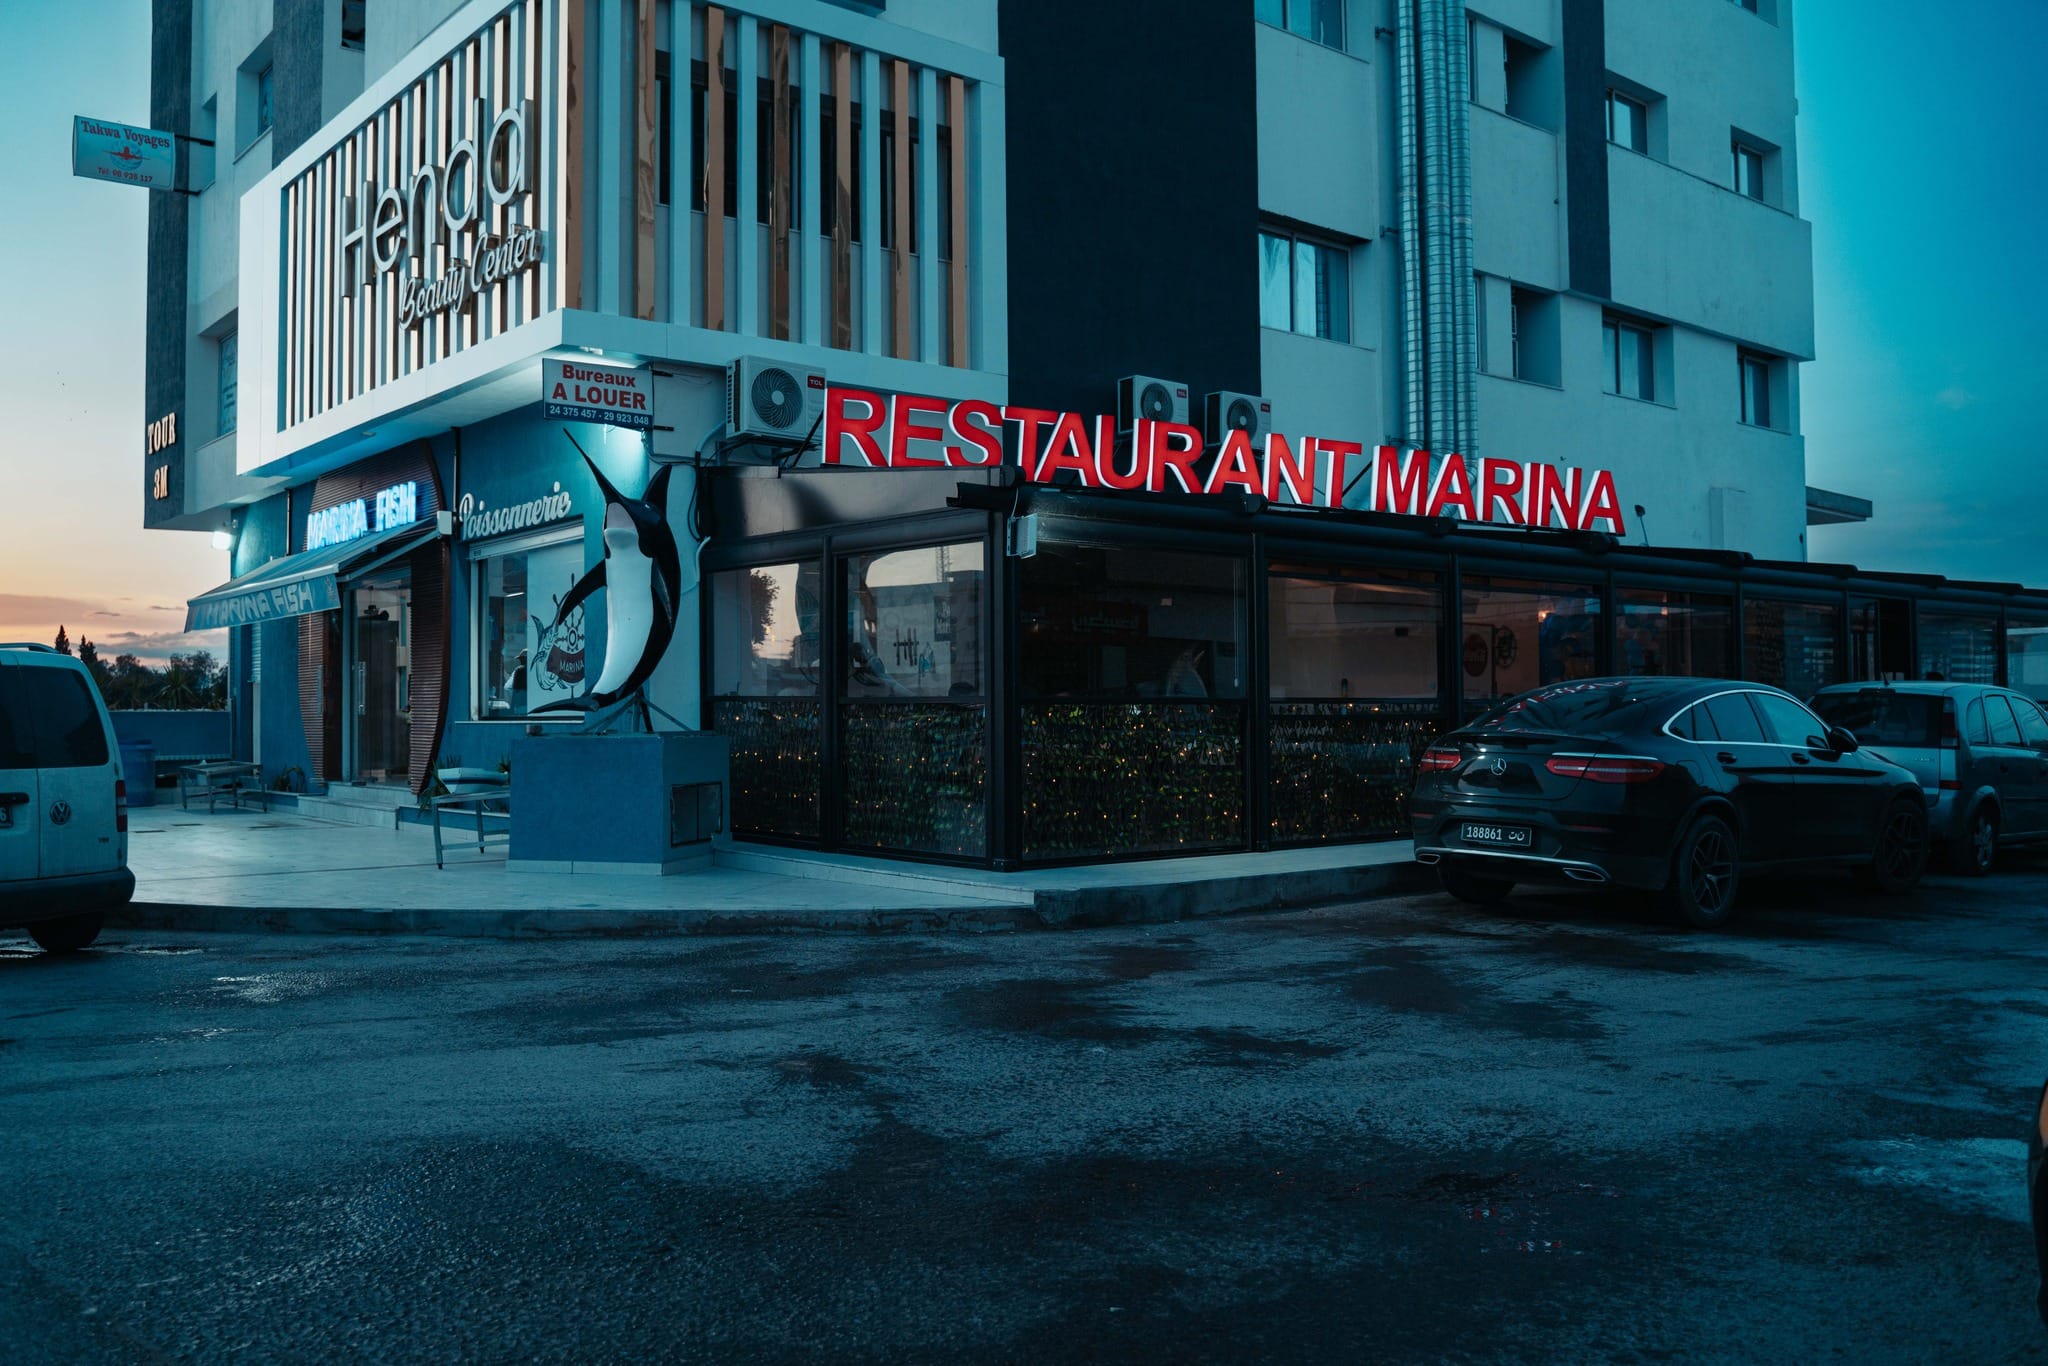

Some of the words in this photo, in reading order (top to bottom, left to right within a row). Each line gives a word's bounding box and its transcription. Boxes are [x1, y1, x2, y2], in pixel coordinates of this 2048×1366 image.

[81, 121, 120, 138] Takwa
[124, 128, 170, 149] Voyages
[341, 98, 533, 298] Henda
[399, 258, 468, 330] Beauty
[471, 223, 541, 293] Center
[552, 382, 568, 401] A
[575, 384, 647, 410] LOUER
[562, 364, 636, 388] Bureaux
[147, 412, 176, 455] TOUR
[549, 405, 561, 415] 24
[563, 406, 579, 417] 375
[581, 409, 597, 419] 457
[604, 411, 614, 421] 29
[616, 413, 632, 423] 923
[633, 415, 649, 425] 048
[822, 387, 1362, 509] RESTAURANT
[1372, 445, 1626, 536] MARINA
[307, 498, 369, 550] MARINA
[376, 481, 417, 532] FISH
[459, 481, 572, 541] Poissonnerie
[207, 590, 271, 625] MARINA
[275, 581, 314, 616] FISH
[560, 659, 585, 673] MARINA
[1466, 826, 1502, 840] 188861
